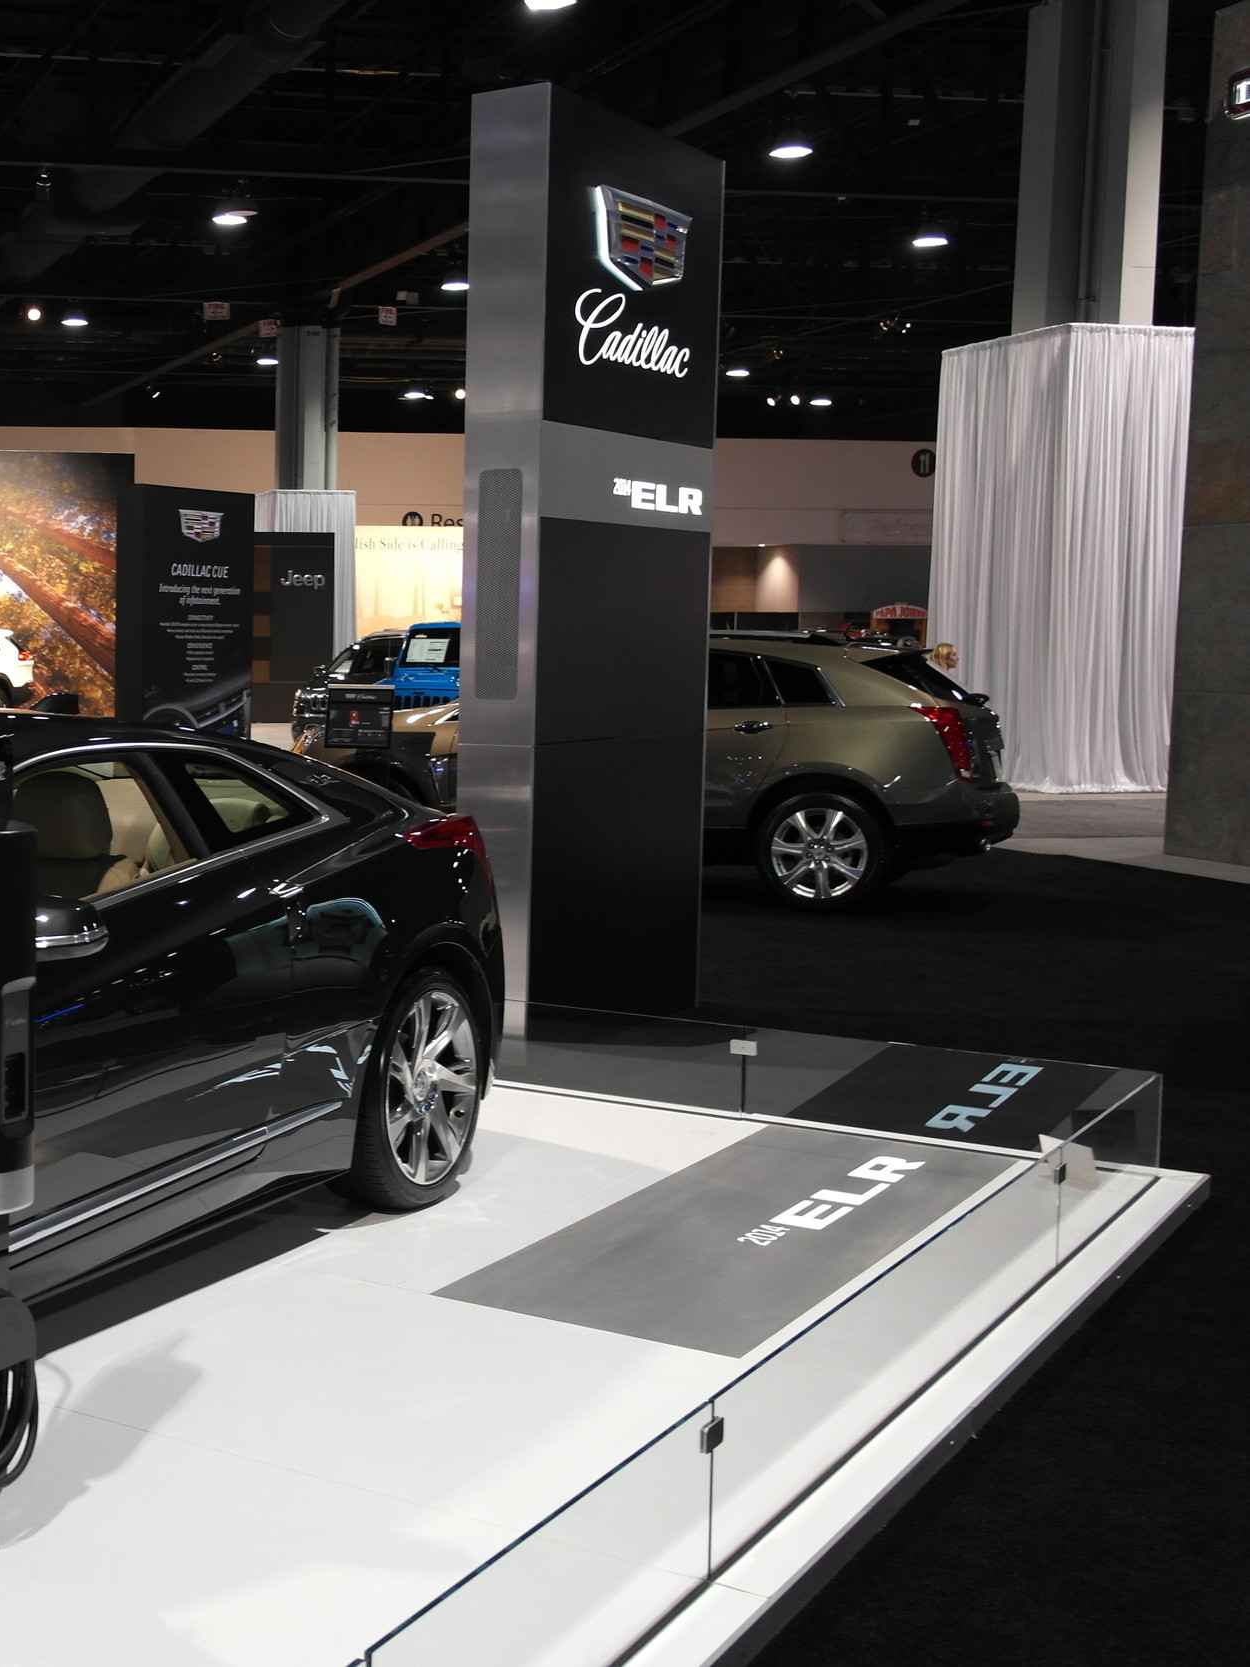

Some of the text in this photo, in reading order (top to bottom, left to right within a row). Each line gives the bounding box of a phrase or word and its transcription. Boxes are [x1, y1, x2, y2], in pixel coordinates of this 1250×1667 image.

[574, 288, 691, 379] Cadillac
[612, 477, 703, 516] 2014 ELR
[379, 537, 405, 550] Side
[408, 538, 418, 550] is
[171, 563, 230, 579] CADILLAC CUE
[279, 569, 326, 590] Jeep
[191, 585, 200, 594] the
[737, 1155, 926, 1247] 2014 ELR
